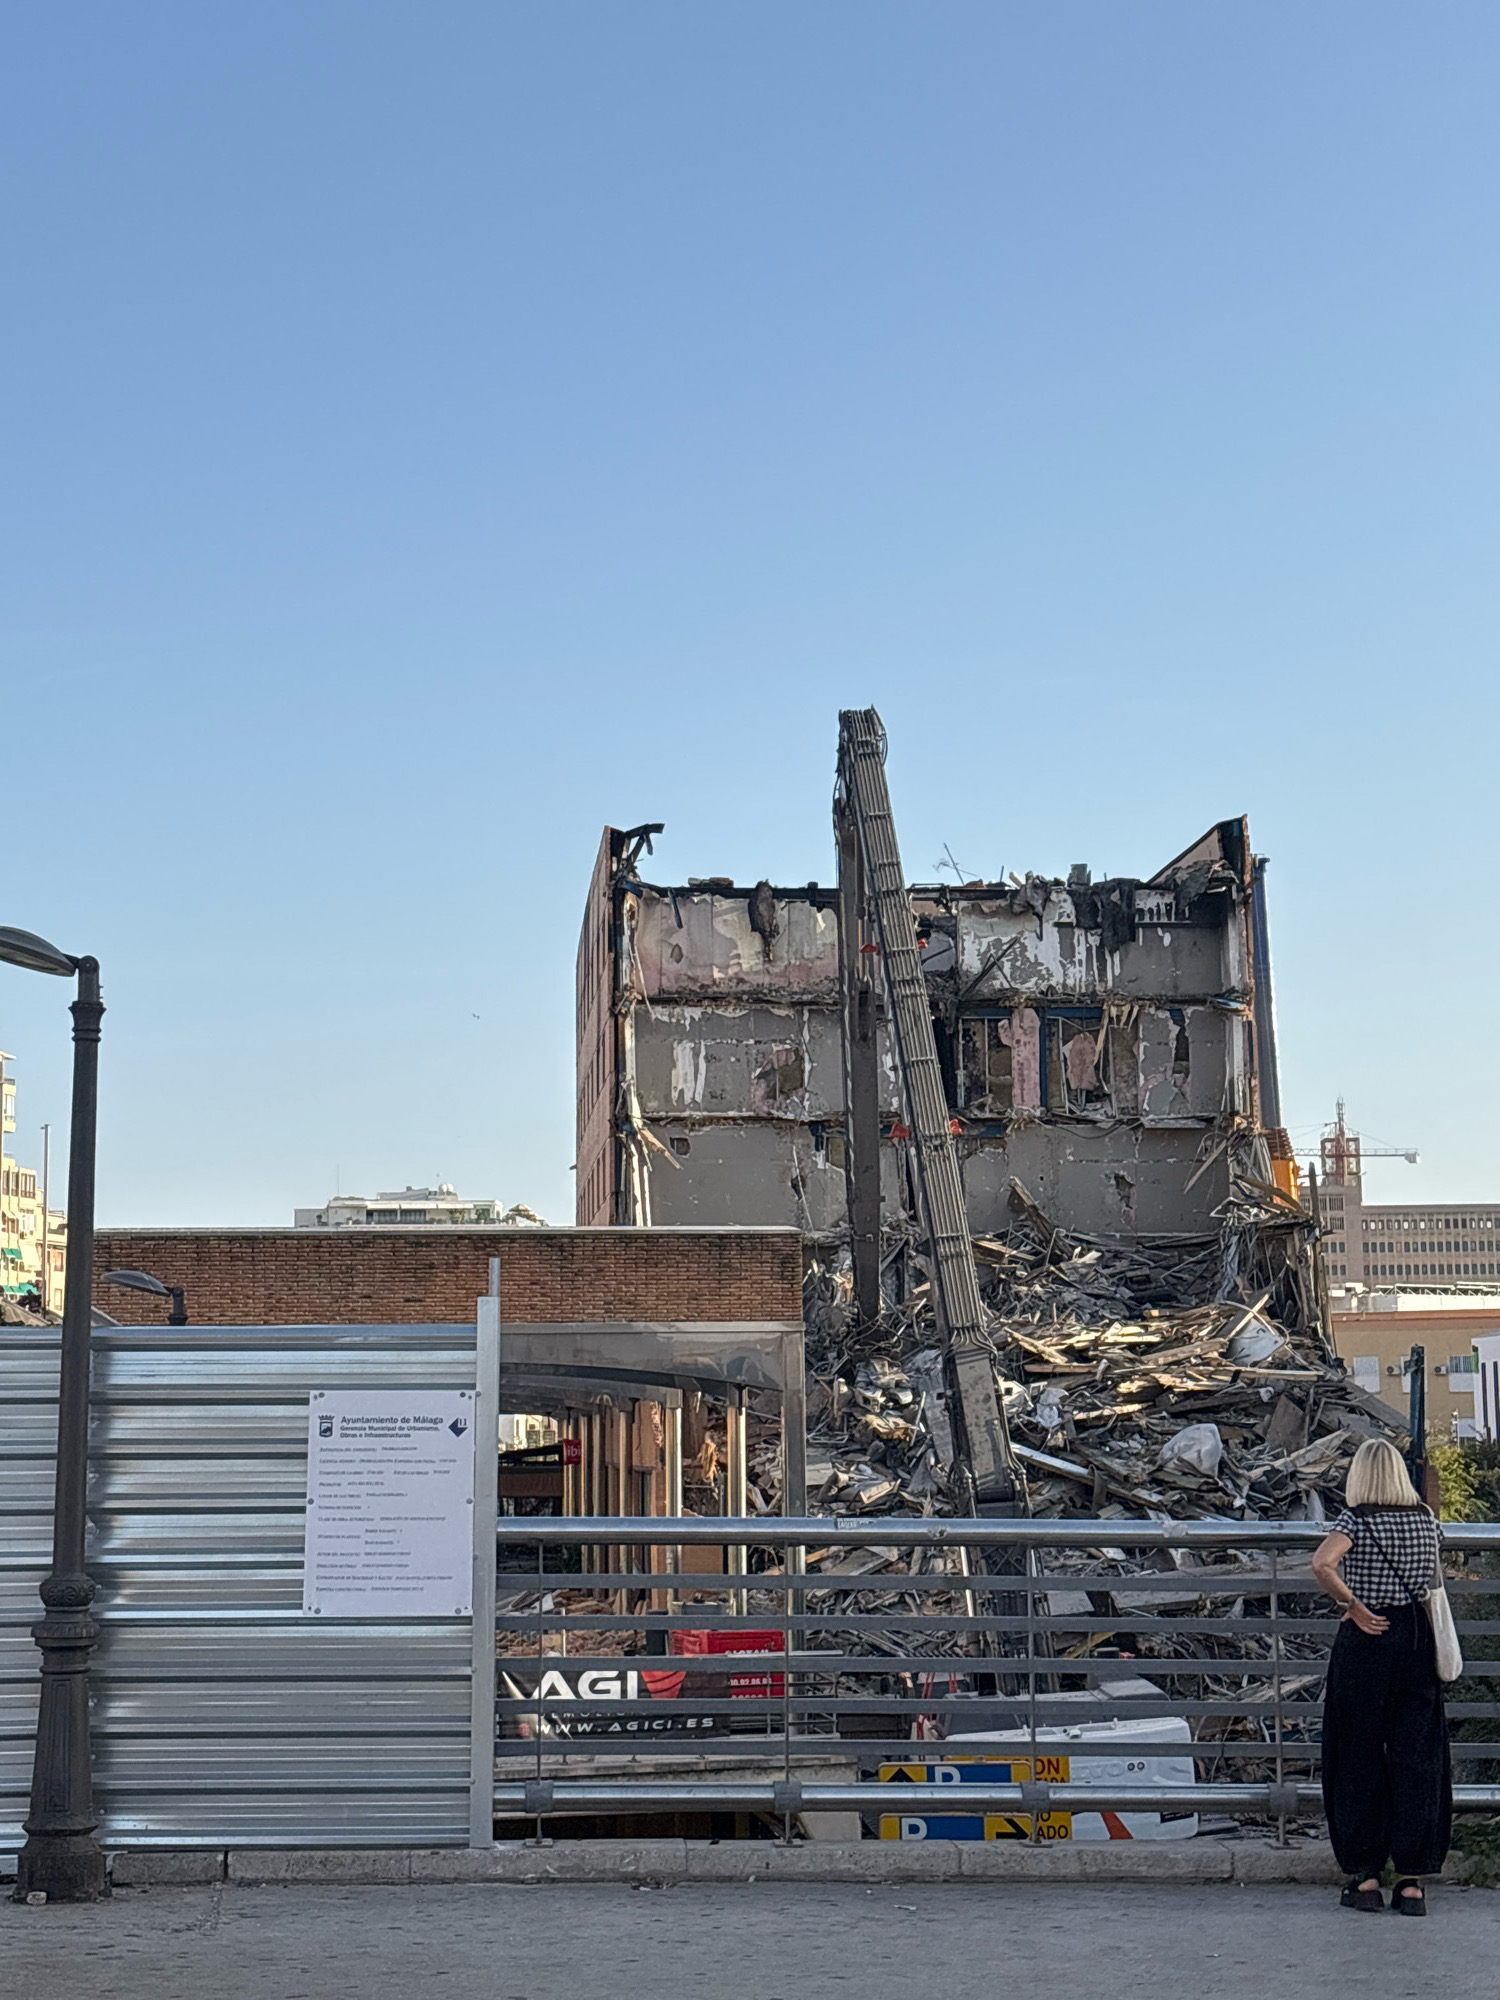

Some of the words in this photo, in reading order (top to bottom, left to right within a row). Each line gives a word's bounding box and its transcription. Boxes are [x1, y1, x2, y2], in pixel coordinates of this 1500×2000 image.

[341, 1415, 399, 1425] Ayuntamiento
[400, 1416, 411, 1424] de
[412, 1415, 444, 1425] Málaga
[567, 1445, 581, 1457] ibi
[536, 1717, 714, 1734] WWW.AGICI.ES
